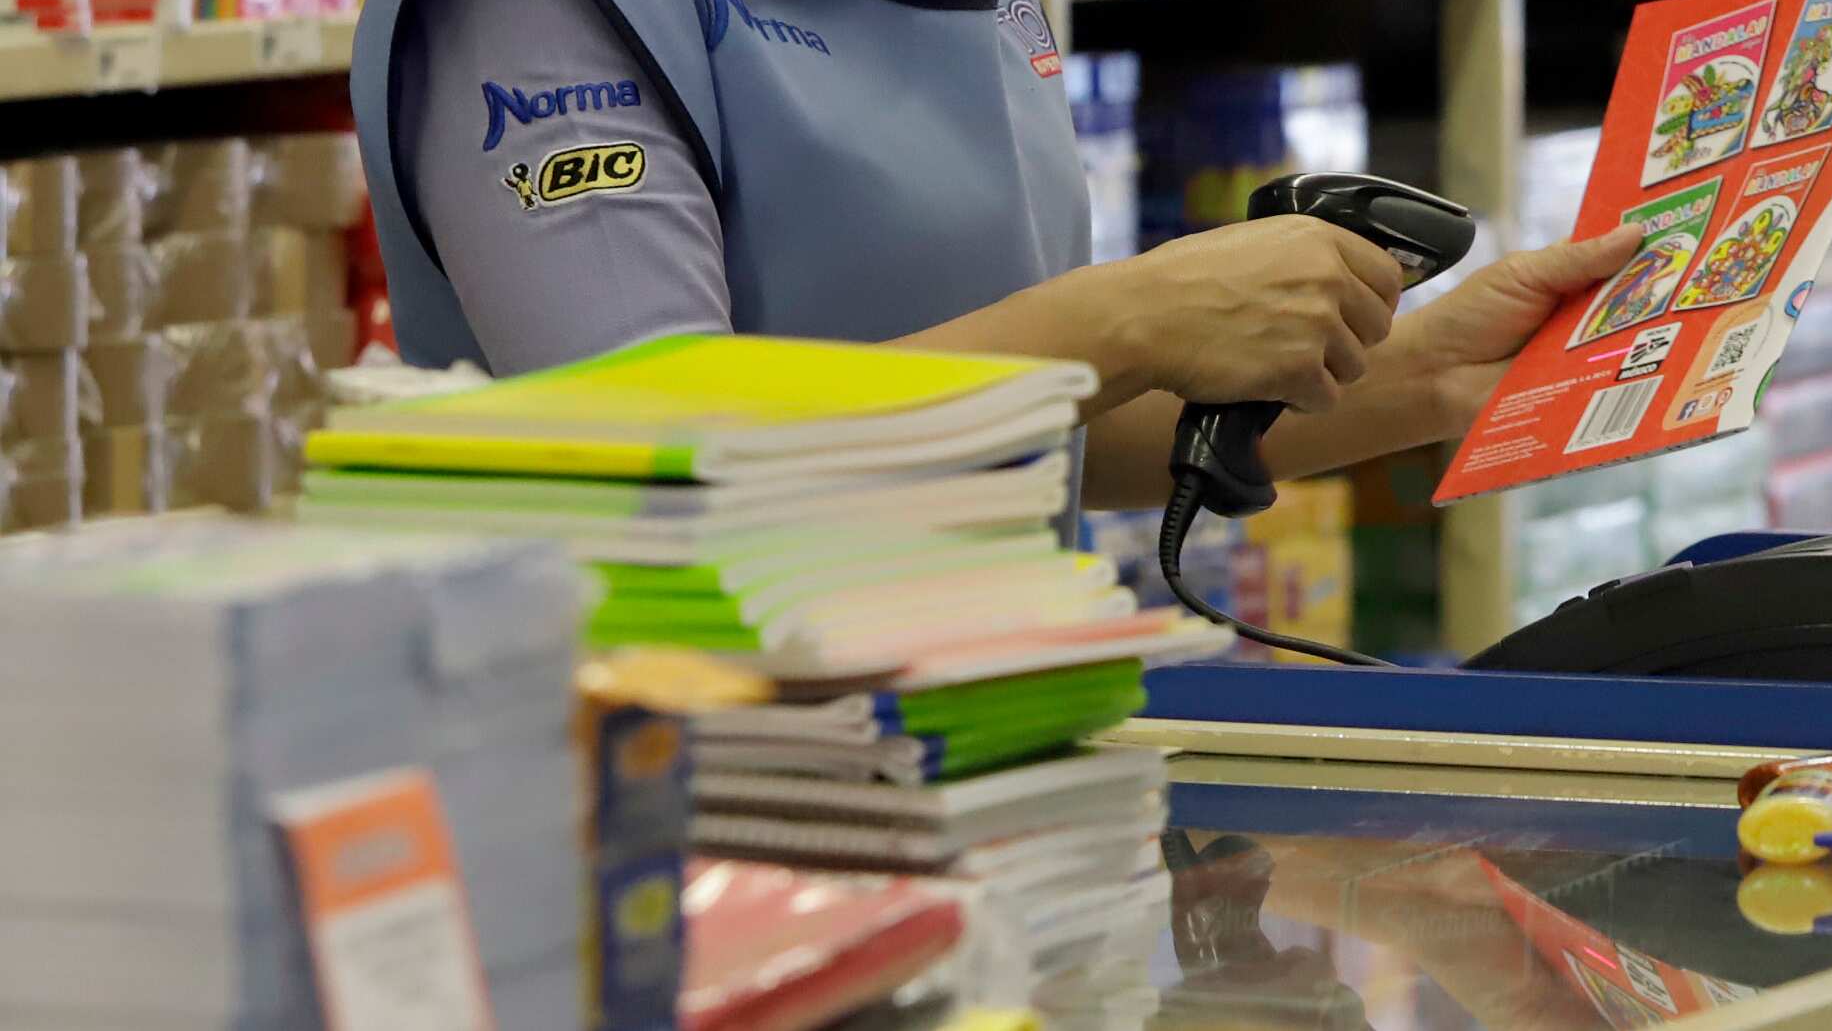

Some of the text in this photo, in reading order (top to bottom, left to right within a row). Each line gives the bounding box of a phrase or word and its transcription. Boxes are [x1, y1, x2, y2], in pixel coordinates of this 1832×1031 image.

[481, 80, 641, 152] Norma
[548, 151, 638, 193] BIC
[1640, 194, 1713, 237] ANDALAS
